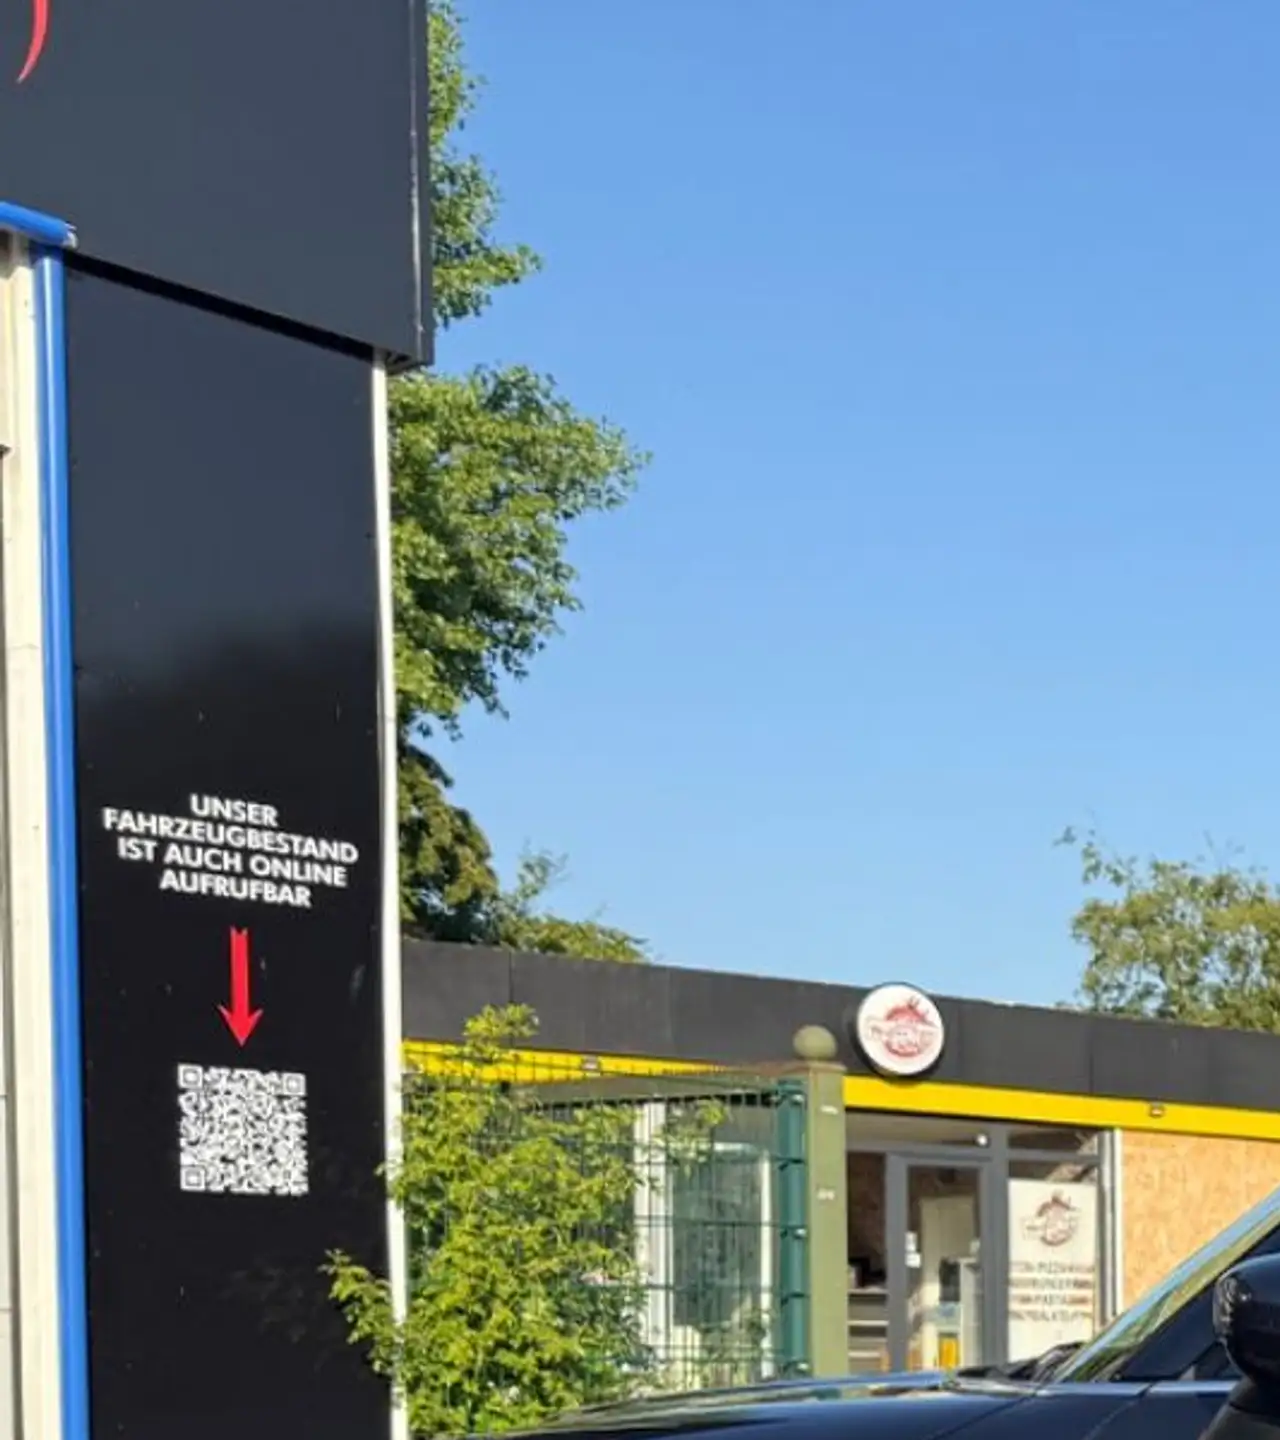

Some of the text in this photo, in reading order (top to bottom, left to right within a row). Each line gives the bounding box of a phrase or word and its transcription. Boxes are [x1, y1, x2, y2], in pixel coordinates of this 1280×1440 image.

[190, 793, 279, 828] UNSER
[103, 807, 360, 864] FAHRZEUGBESTAND
[117, 836, 348, 888] IST AUCH ONLINE
[159, 869, 312, 908] AUFRUFBAR
